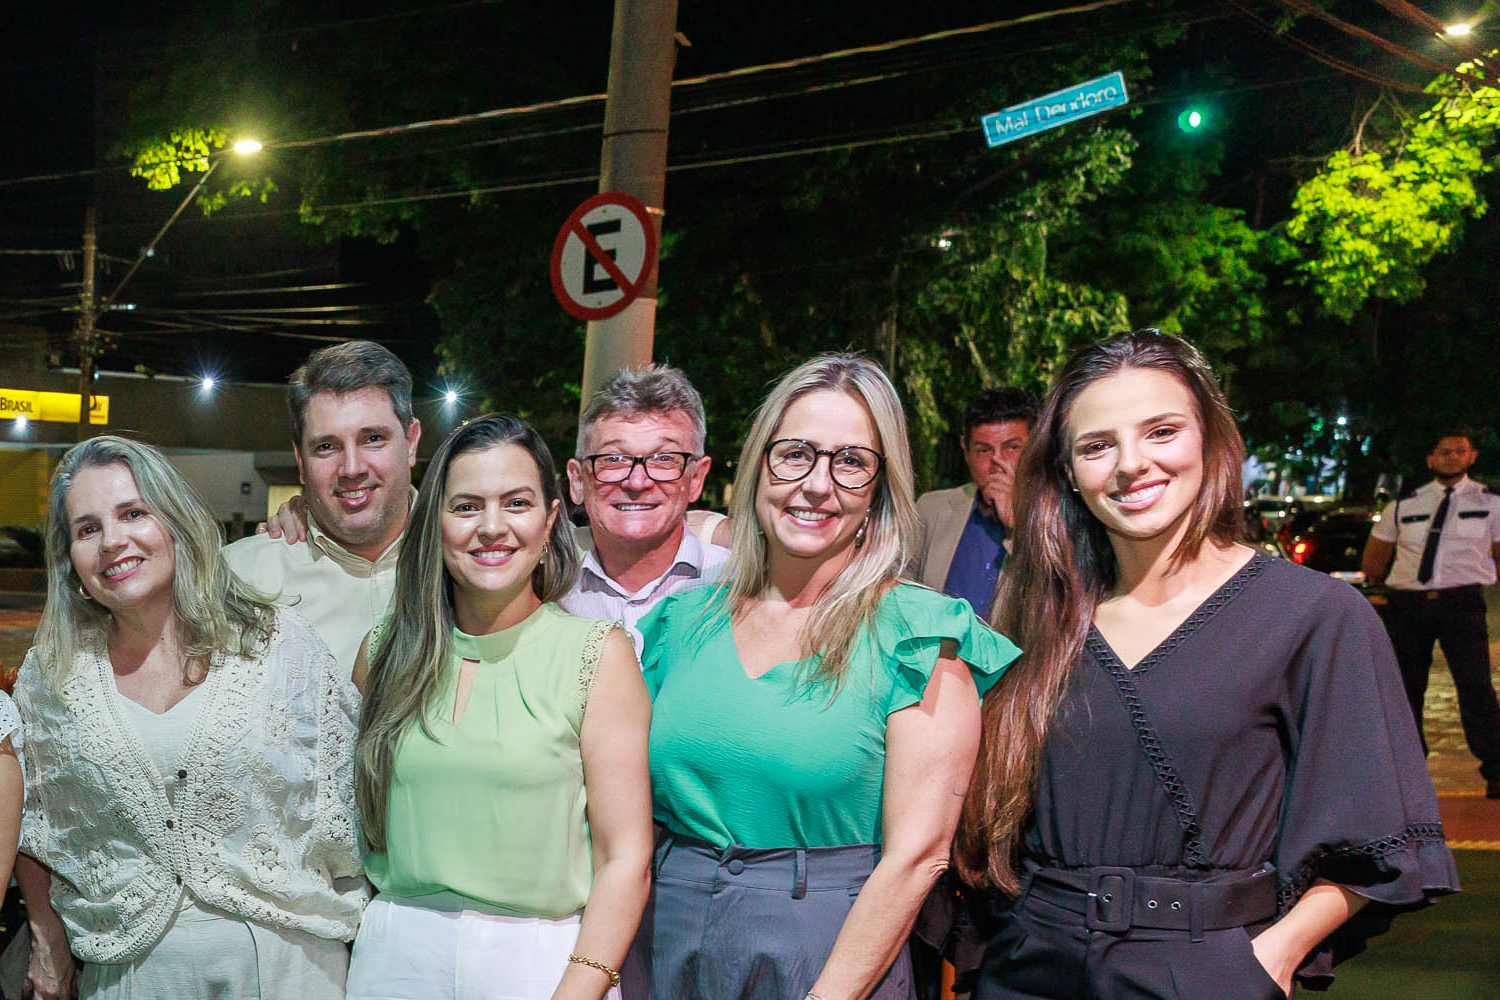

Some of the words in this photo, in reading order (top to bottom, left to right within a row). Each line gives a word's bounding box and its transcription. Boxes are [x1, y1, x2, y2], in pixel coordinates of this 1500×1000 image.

[995, 111, 1029, 136] Mal
[583, 218, 622, 294] E
[0, 397, 33, 413] BRASIL
